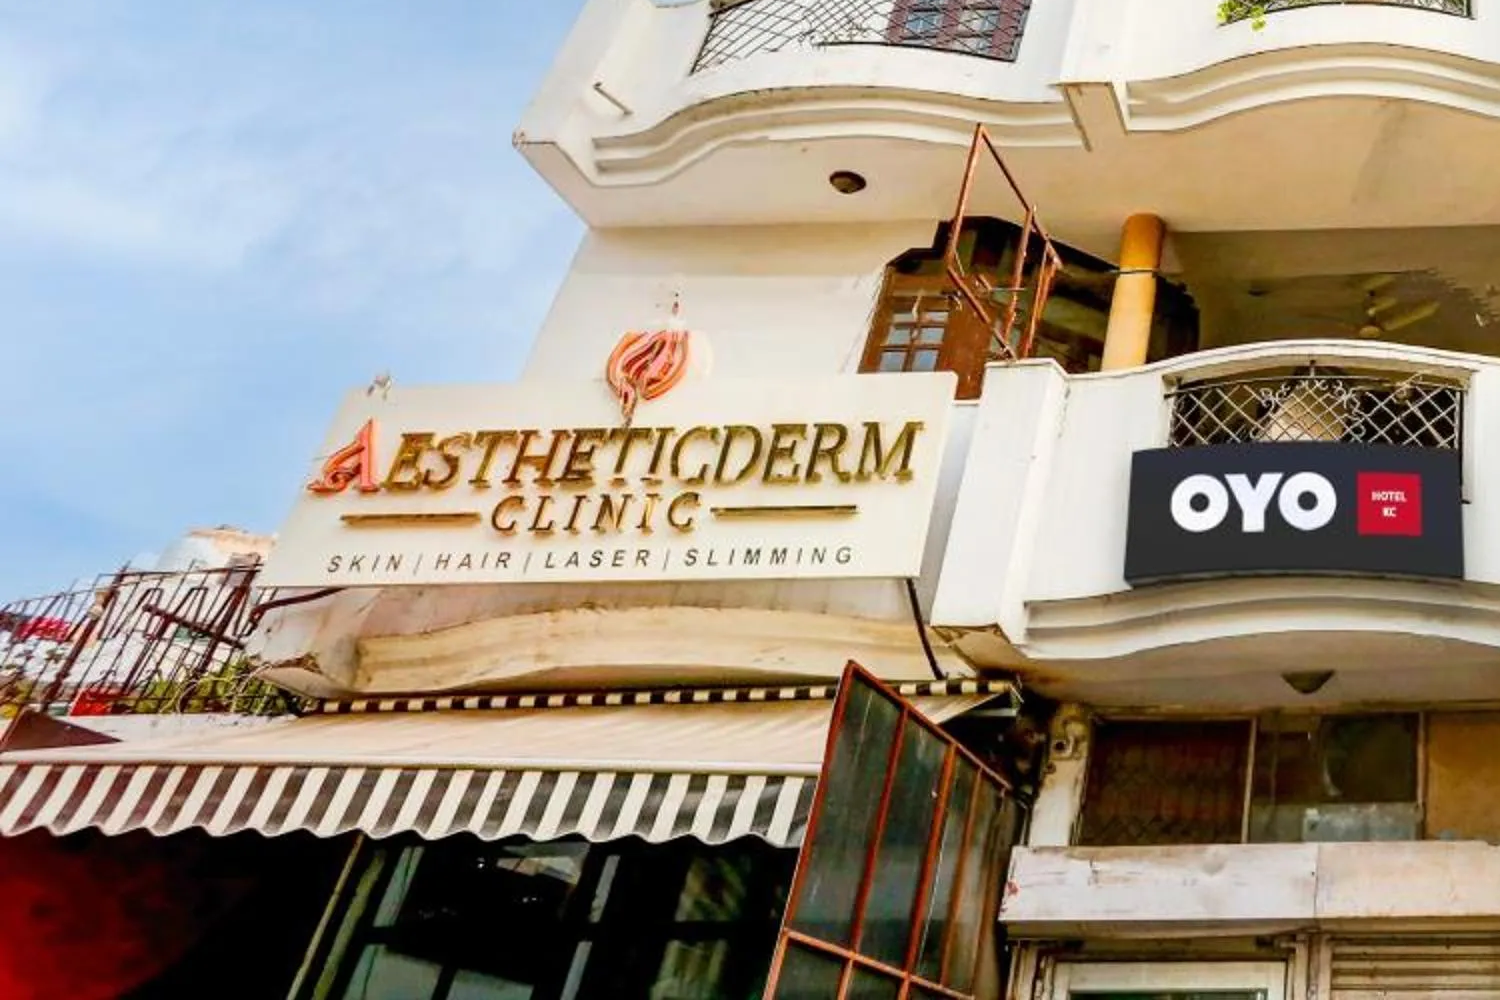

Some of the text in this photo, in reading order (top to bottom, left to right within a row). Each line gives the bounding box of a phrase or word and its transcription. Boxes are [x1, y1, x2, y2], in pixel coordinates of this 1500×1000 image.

[307, 417, 925, 492] AESTHETICDERM
[490, 492, 702, 538] CLINIC
[1170, 471, 1337, 532] OYO
[1371, 490, 1407, 503] HOTEL
[327, 546, 853, 574] SKIN HAIR LASER SLIMMING
